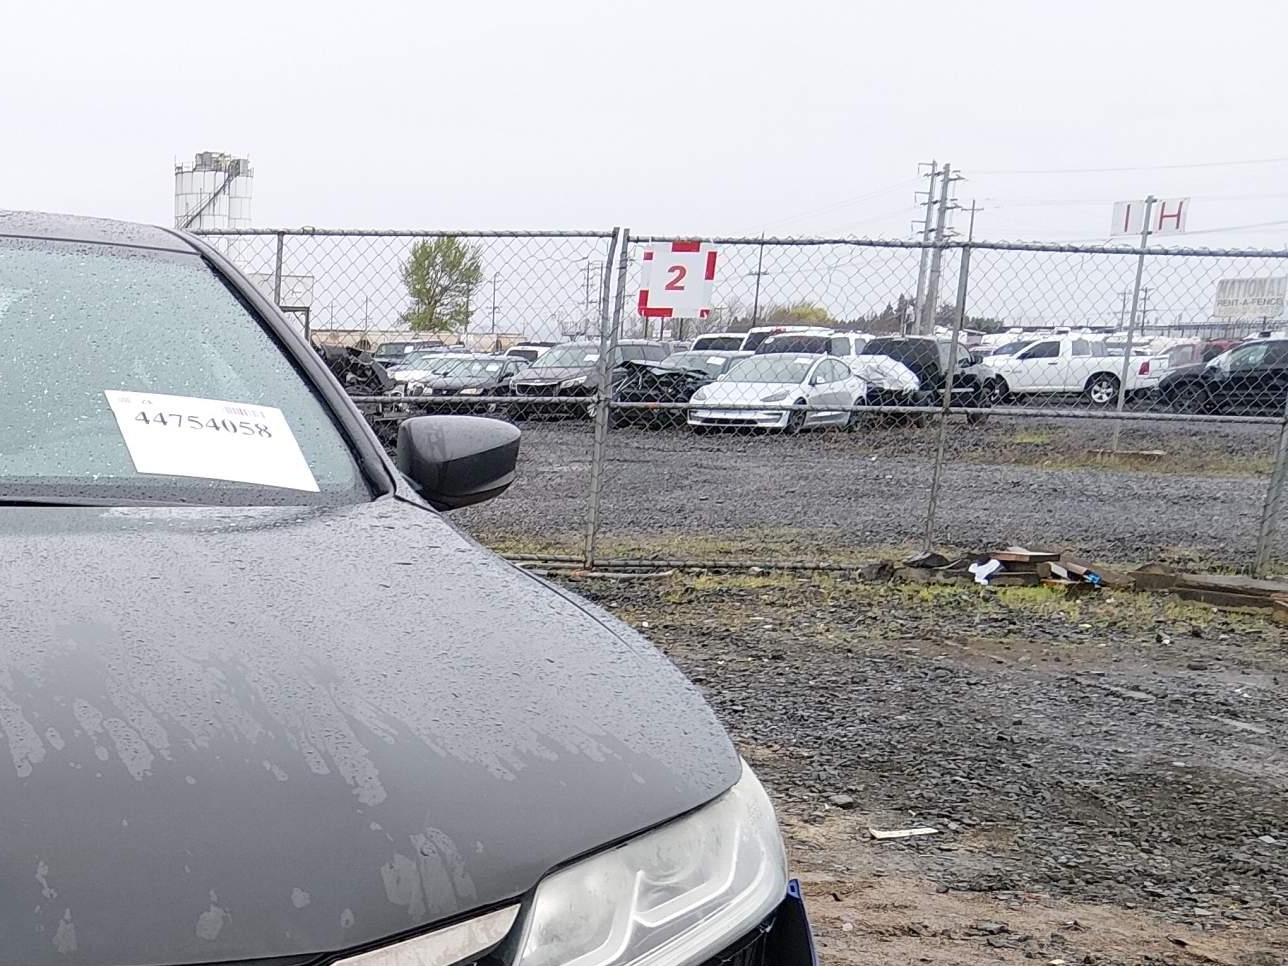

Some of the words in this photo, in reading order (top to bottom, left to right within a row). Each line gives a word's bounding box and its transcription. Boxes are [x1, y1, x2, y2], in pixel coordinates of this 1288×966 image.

[1158, 200, 1184, 231] H
[664, 265, 687, 291] 2
[134, 411, 273, 438] 44754058
